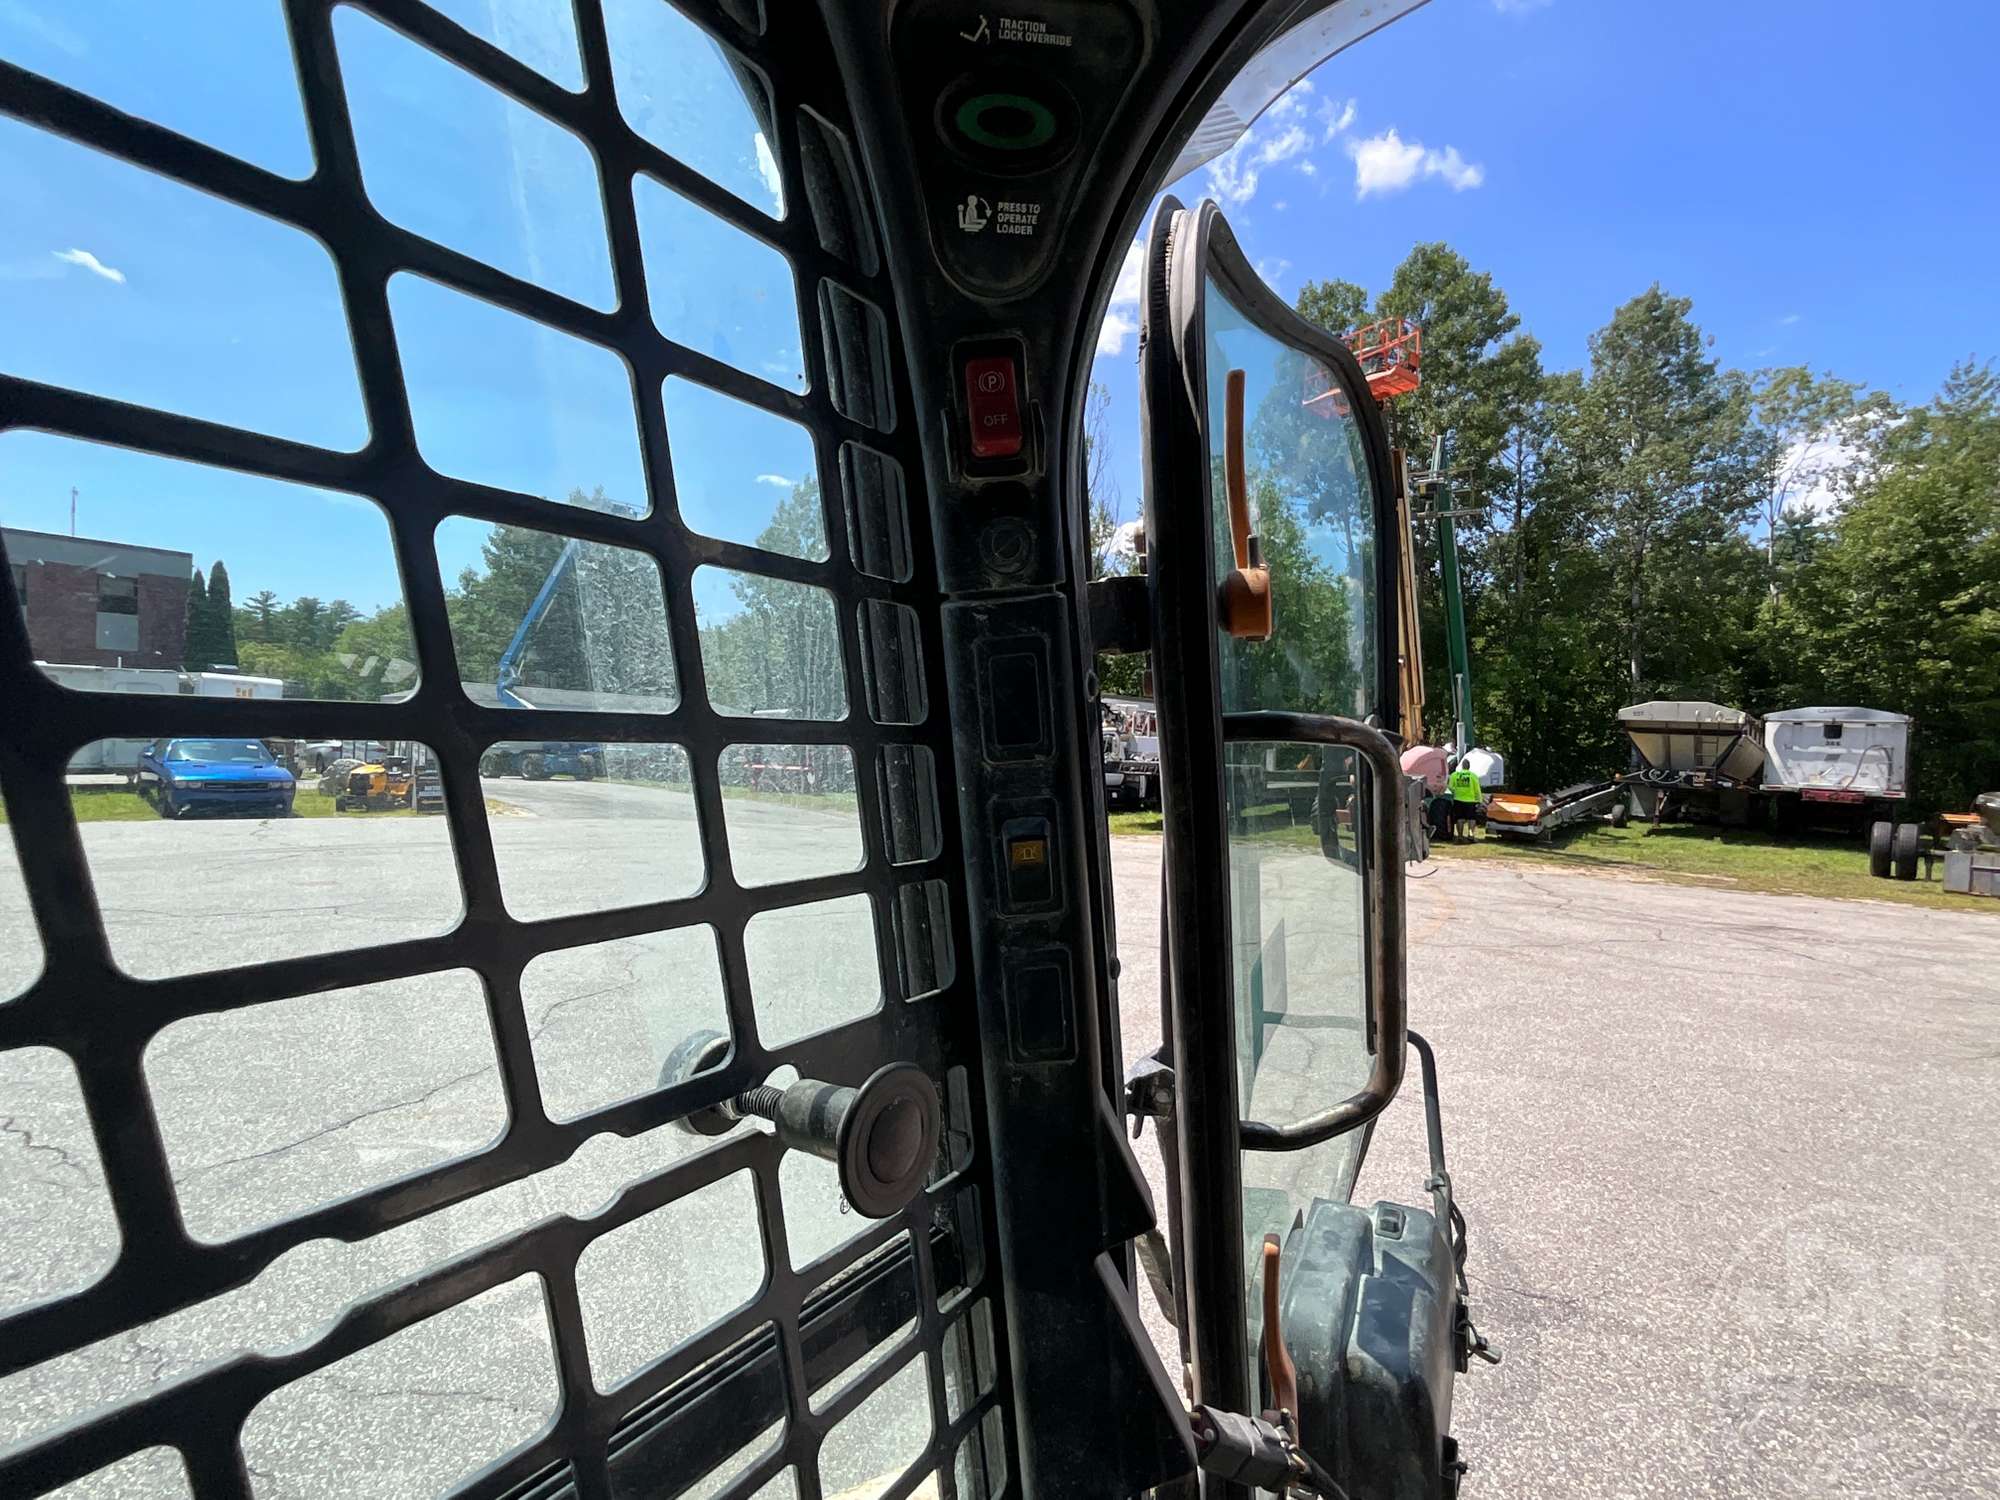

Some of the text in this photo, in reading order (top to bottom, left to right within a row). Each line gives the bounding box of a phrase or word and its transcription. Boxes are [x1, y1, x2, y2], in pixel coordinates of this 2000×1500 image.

[999, 17, 1048, 33] TRACTION
[998, 29, 1073, 47] LOCK OVERRIDE
[997, 201, 1041, 214] PRESS TO
[997, 212, 1038, 225] OPERATE
[996, 223, 1033, 235] LOADER
[983, 414, 1009, 427] OFF
